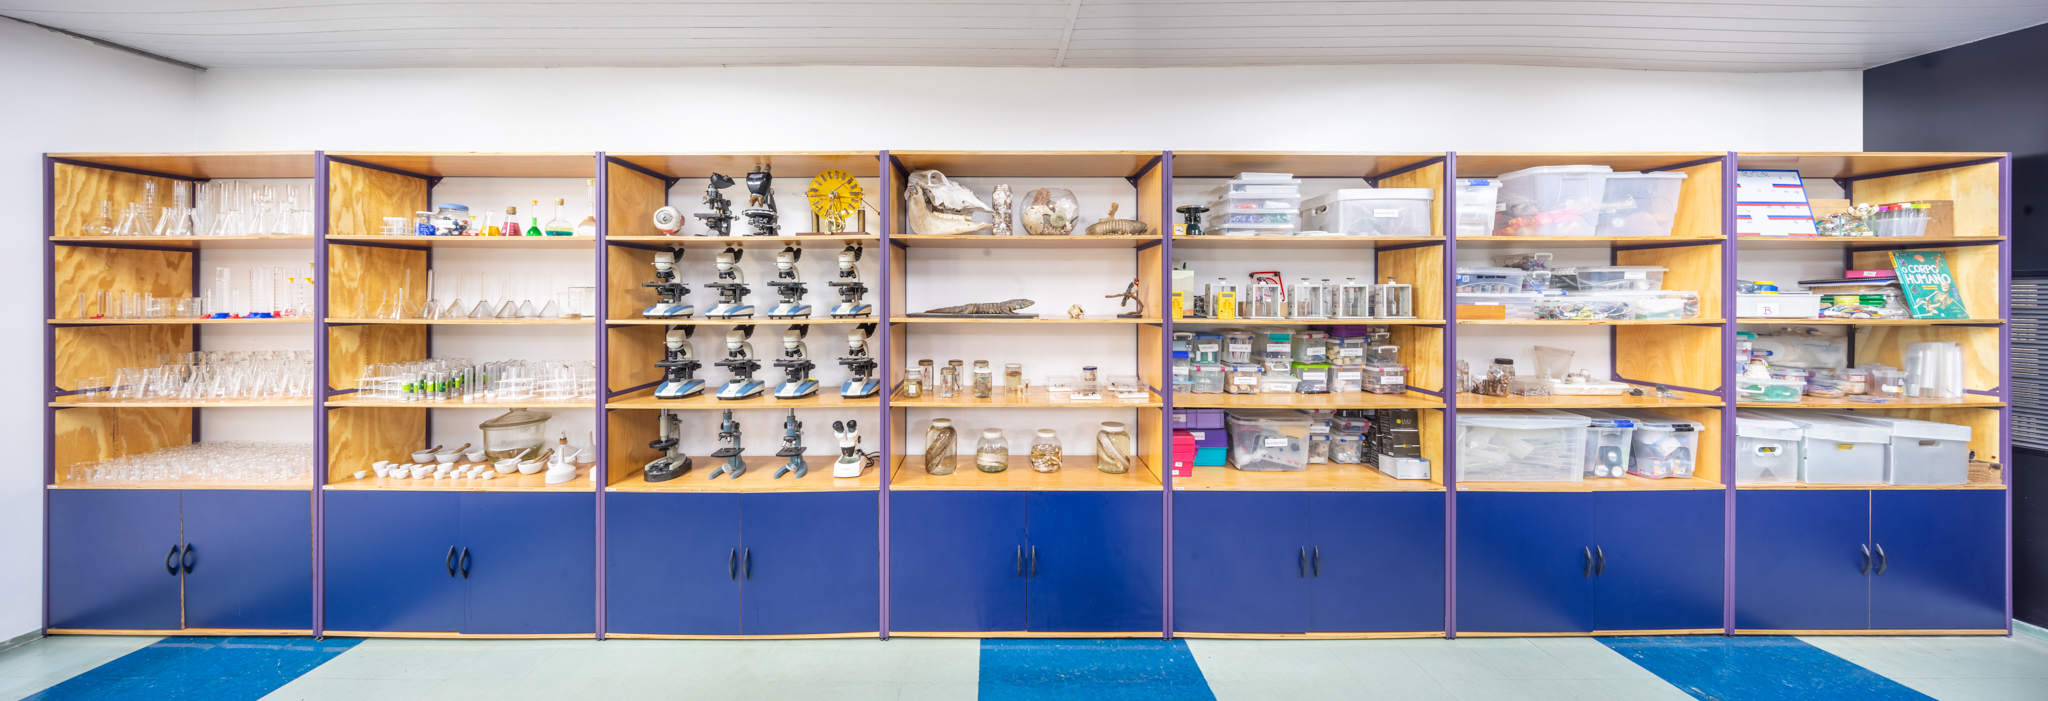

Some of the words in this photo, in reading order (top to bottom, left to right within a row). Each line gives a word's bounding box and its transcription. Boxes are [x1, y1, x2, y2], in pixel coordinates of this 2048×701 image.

[1901, 266, 1908, 274] O
[1908, 264, 1939, 274] CORPO
[1904, 273, 1951, 285] HUMANO
[1762, 306, 1773, 315] B
